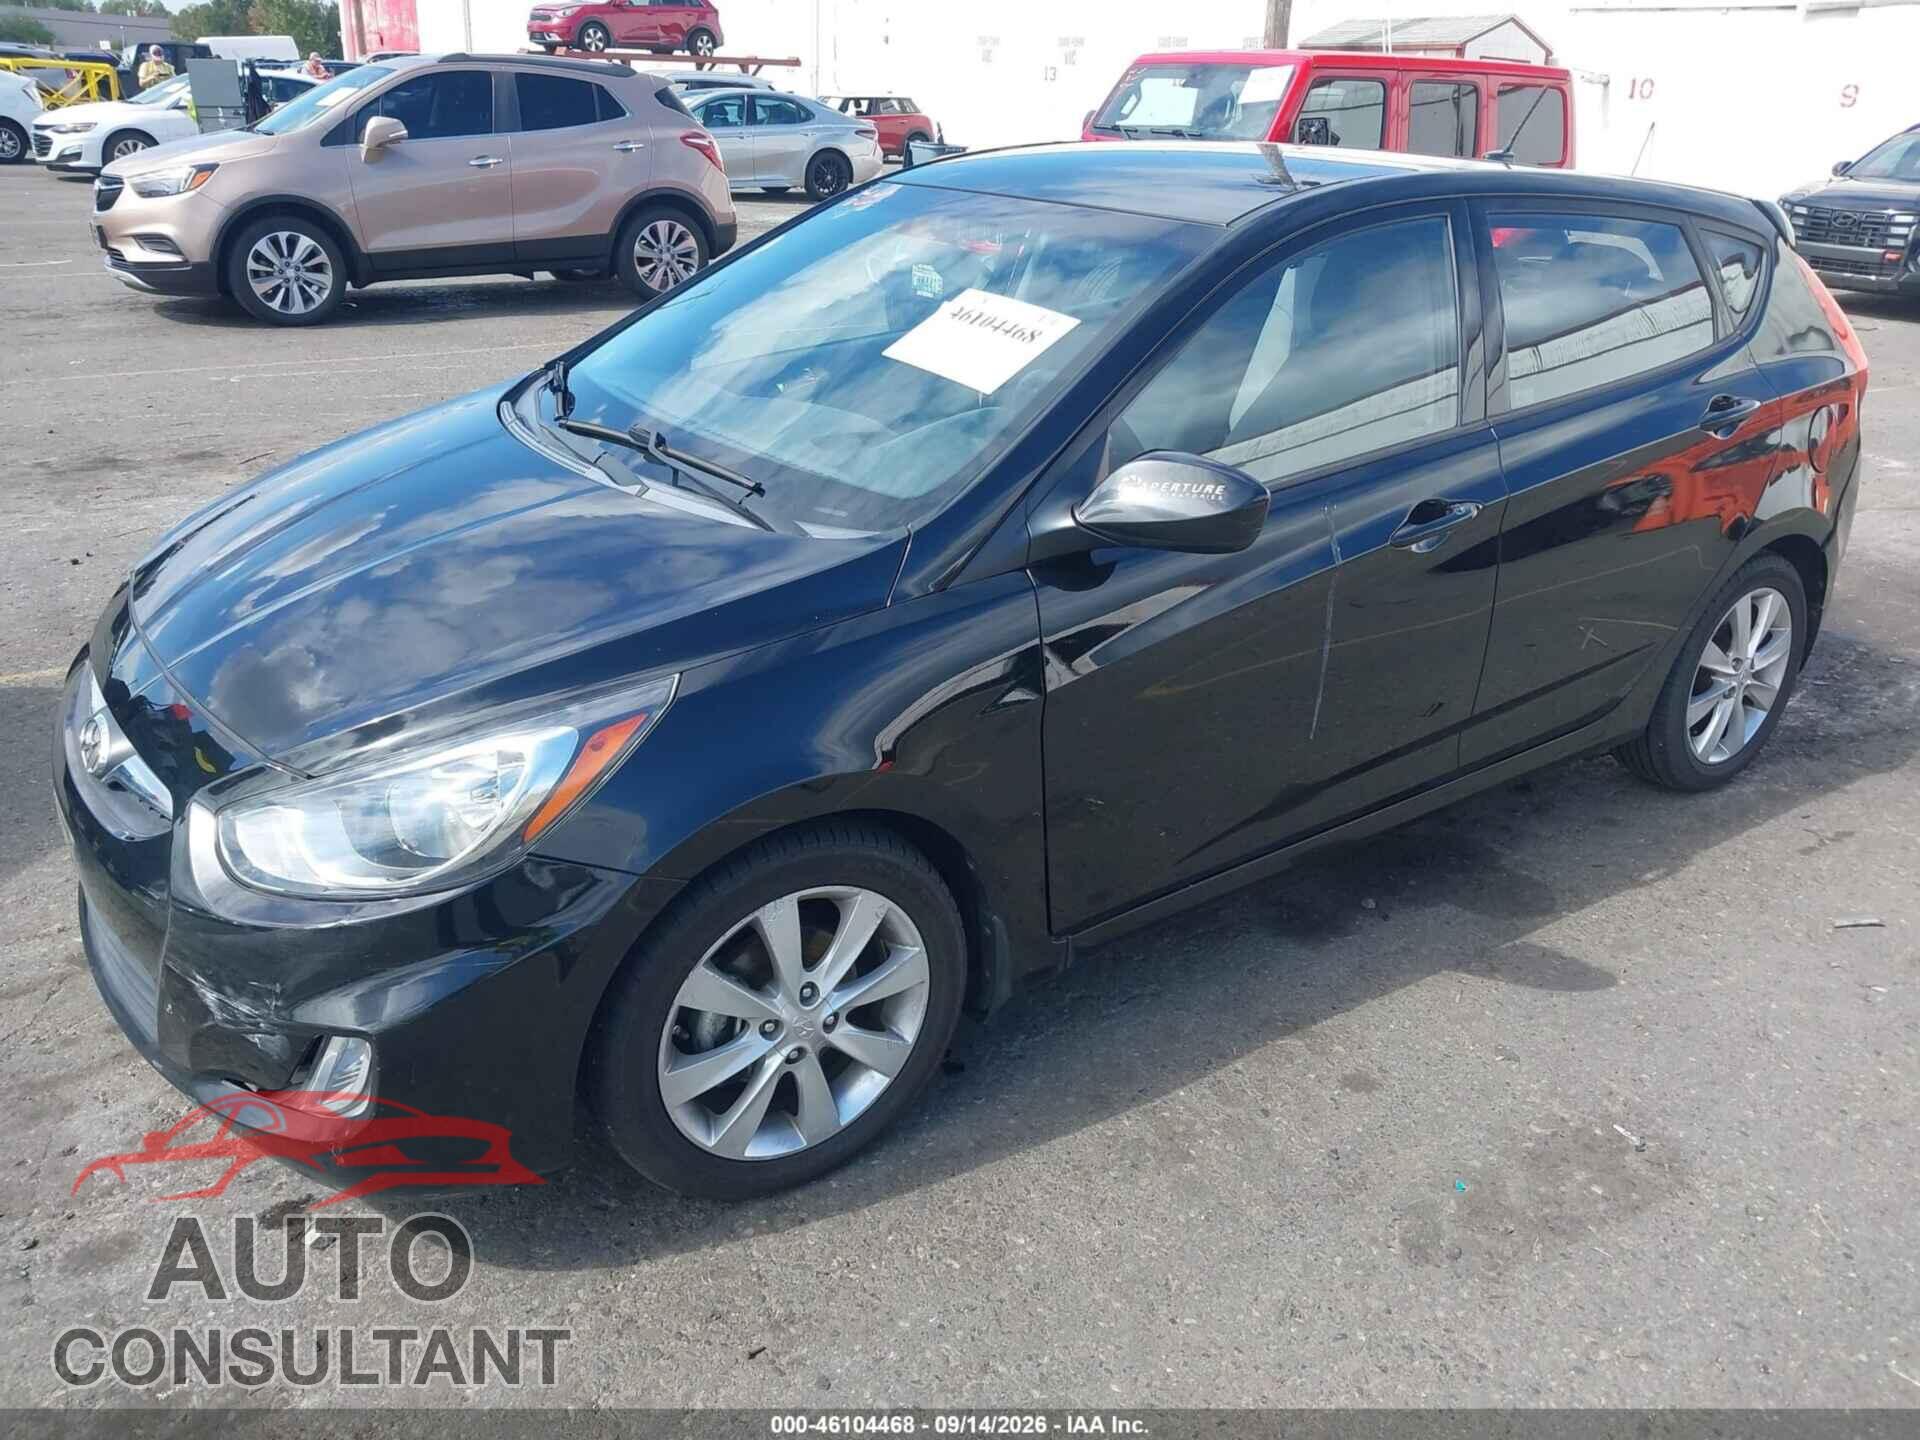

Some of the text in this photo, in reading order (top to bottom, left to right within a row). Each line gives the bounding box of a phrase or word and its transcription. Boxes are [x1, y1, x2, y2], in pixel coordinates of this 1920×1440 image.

[1628, 78, 1655, 100] 10
[1840, 83, 1860, 108] 9
[951, 306, 1042, 342] 46104468
